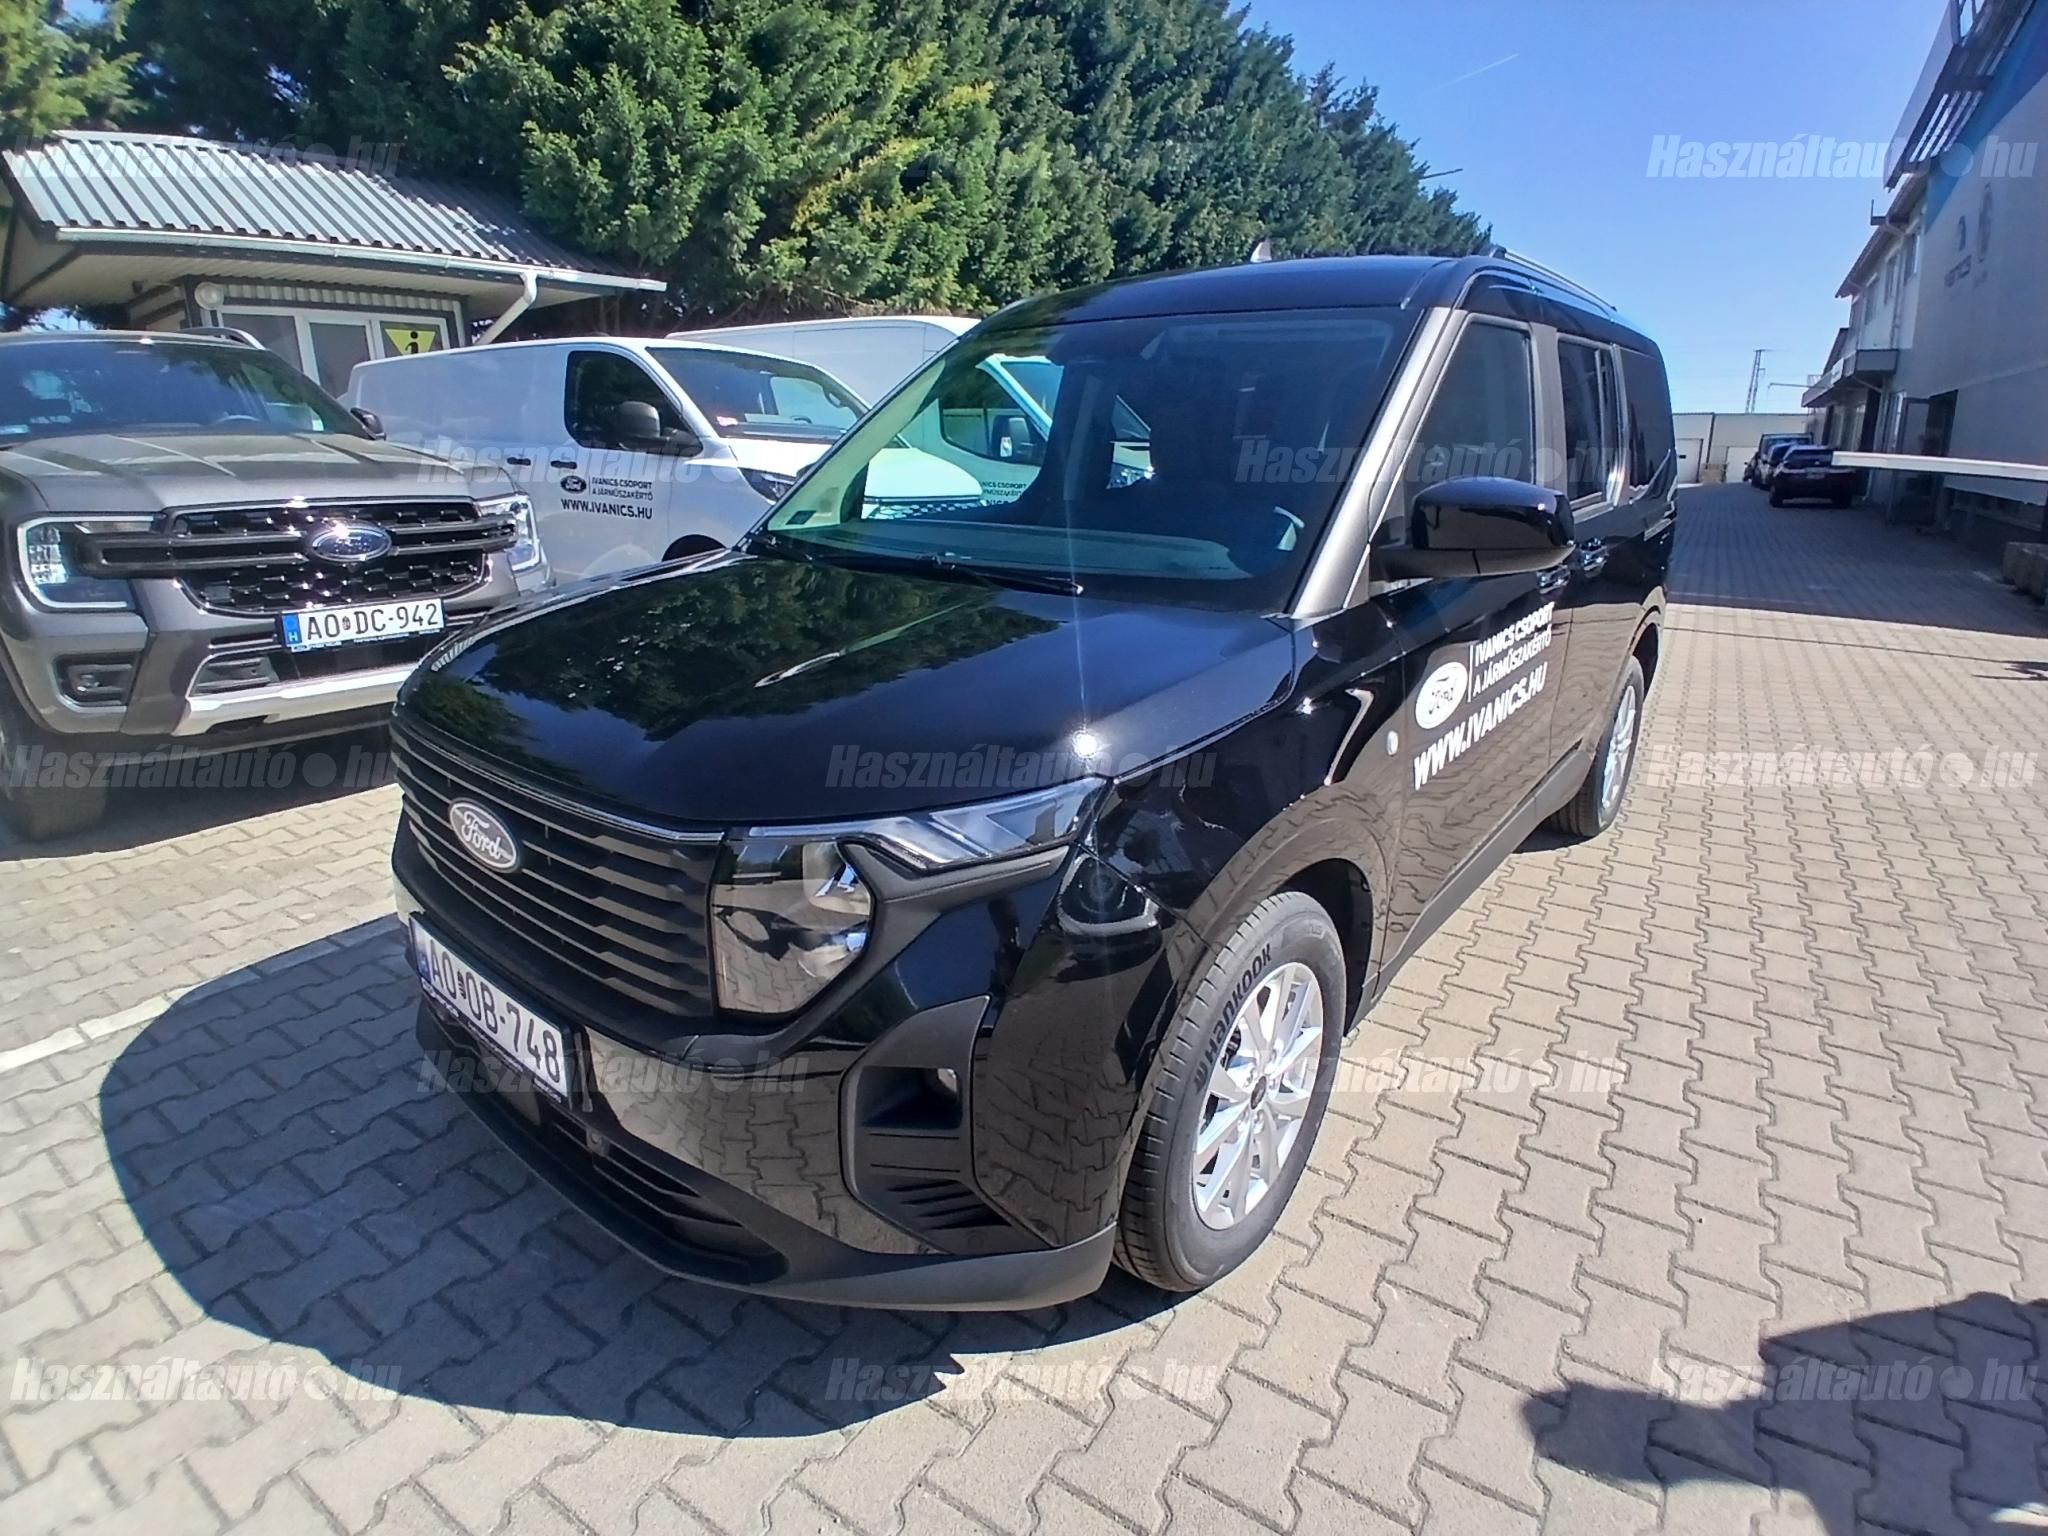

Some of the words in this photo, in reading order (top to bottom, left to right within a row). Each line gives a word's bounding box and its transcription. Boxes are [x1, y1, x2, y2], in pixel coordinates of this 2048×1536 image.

[591, 477, 619, 487] IVANICS
[619, 479, 653, 490] CSOPORT
[561, 498, 653, 520] WWW.IVANICS.HU
[289, 631, 299, 642] H
[306, 613, 341, 641] AO
[353, 602, 439, 635] DC-942
[1475, 624, 1515, 667] IVANICS
[1515, 601, 1555, 642] CSOPORT
[1473, 674, 1482, 697] A
[1413, 661, 1549, 791] WWW.IVANICS.HU
[461, 810, 501, 860] Ford
[430, 939, 457, 1000] AO
[465, 971, 561, 1084] OB-748
